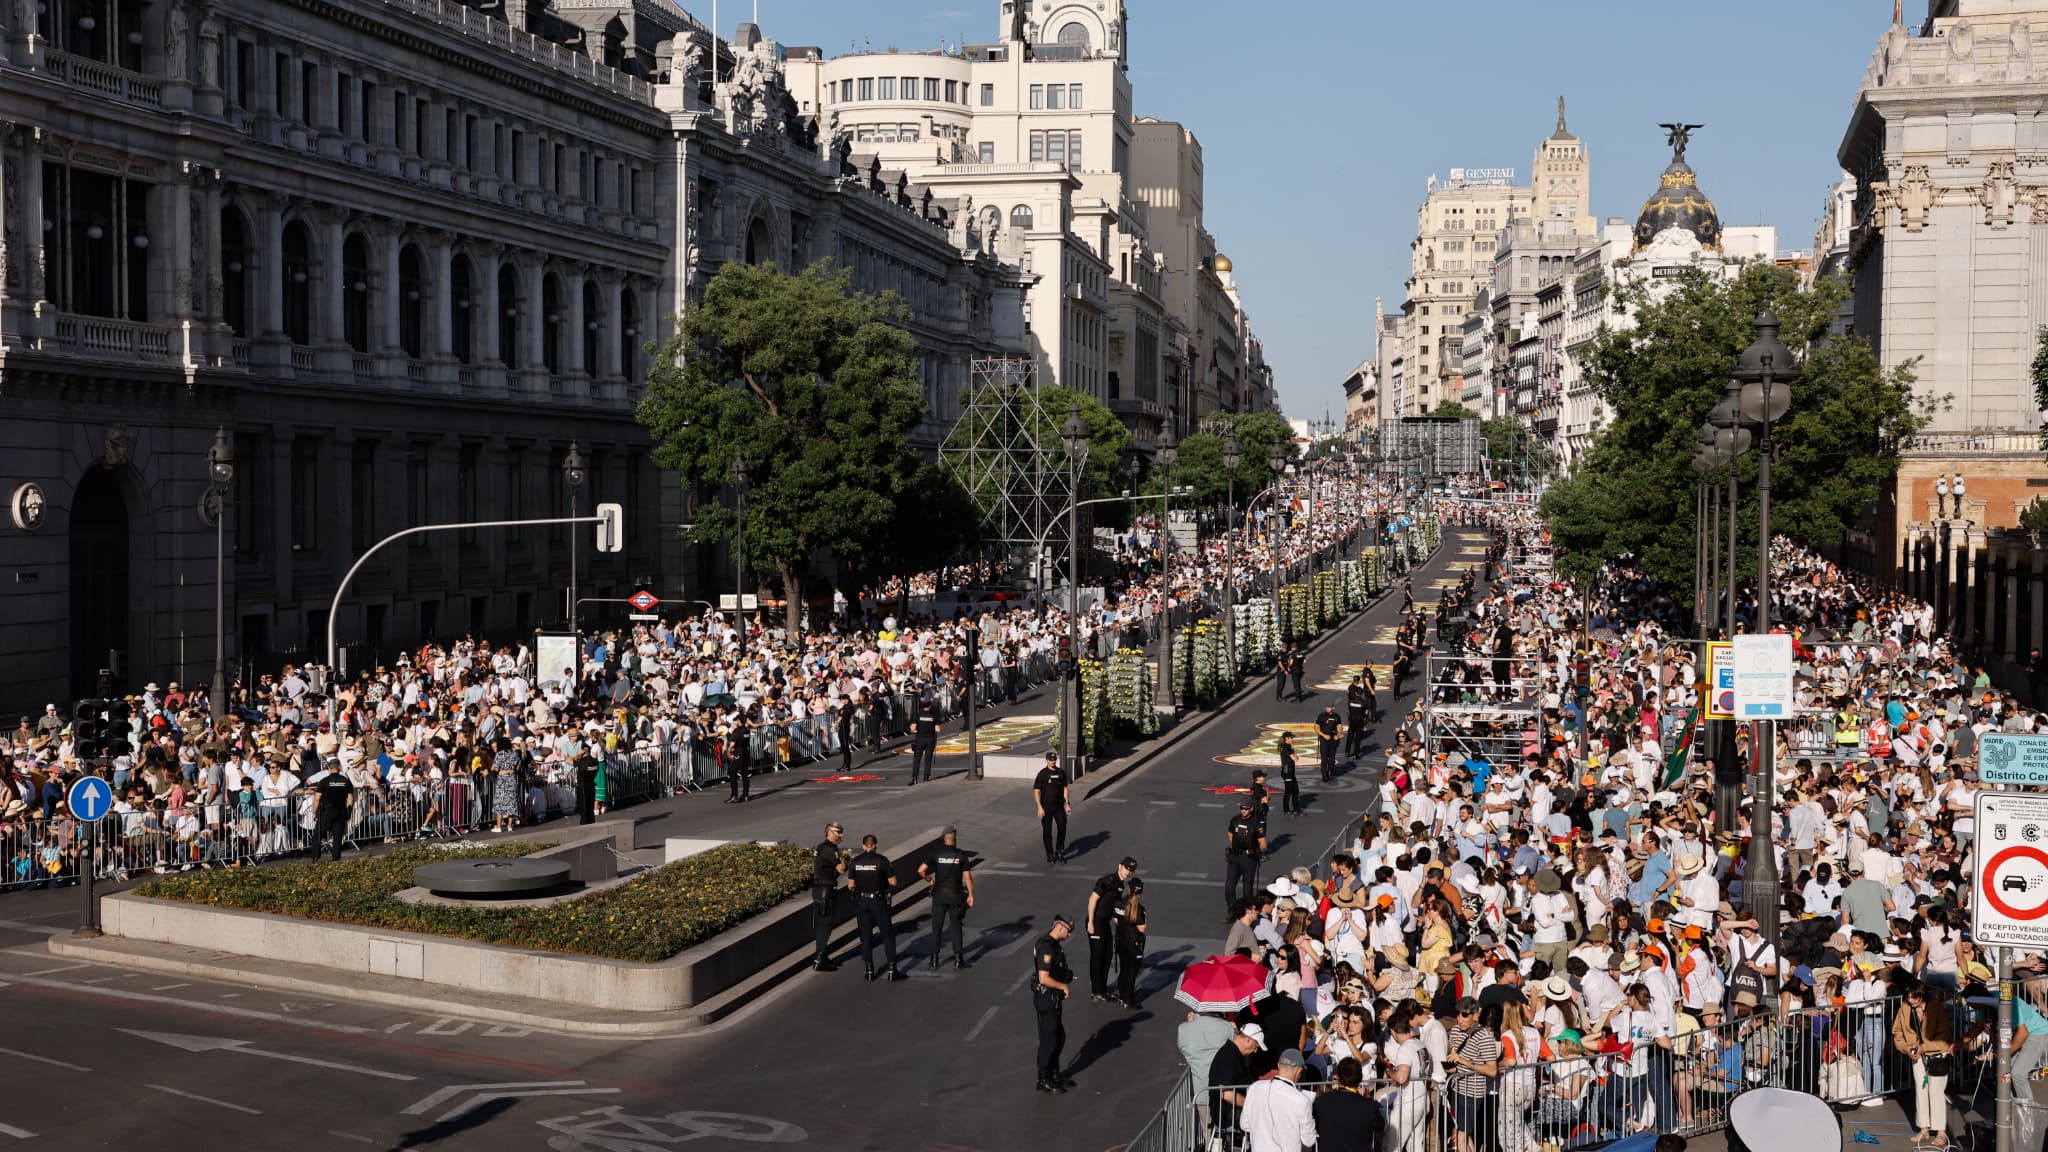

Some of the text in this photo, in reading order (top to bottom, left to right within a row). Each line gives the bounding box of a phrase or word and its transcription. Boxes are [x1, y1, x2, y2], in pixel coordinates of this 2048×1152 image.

[1466, 168, 1515, 178] GENERALI
[1986, 770, 2026, 780] Distrito
[1983, 922, 2018, 931] EXCEPTO
[1995, 932, 2048, 942] AUTORIZADOS
